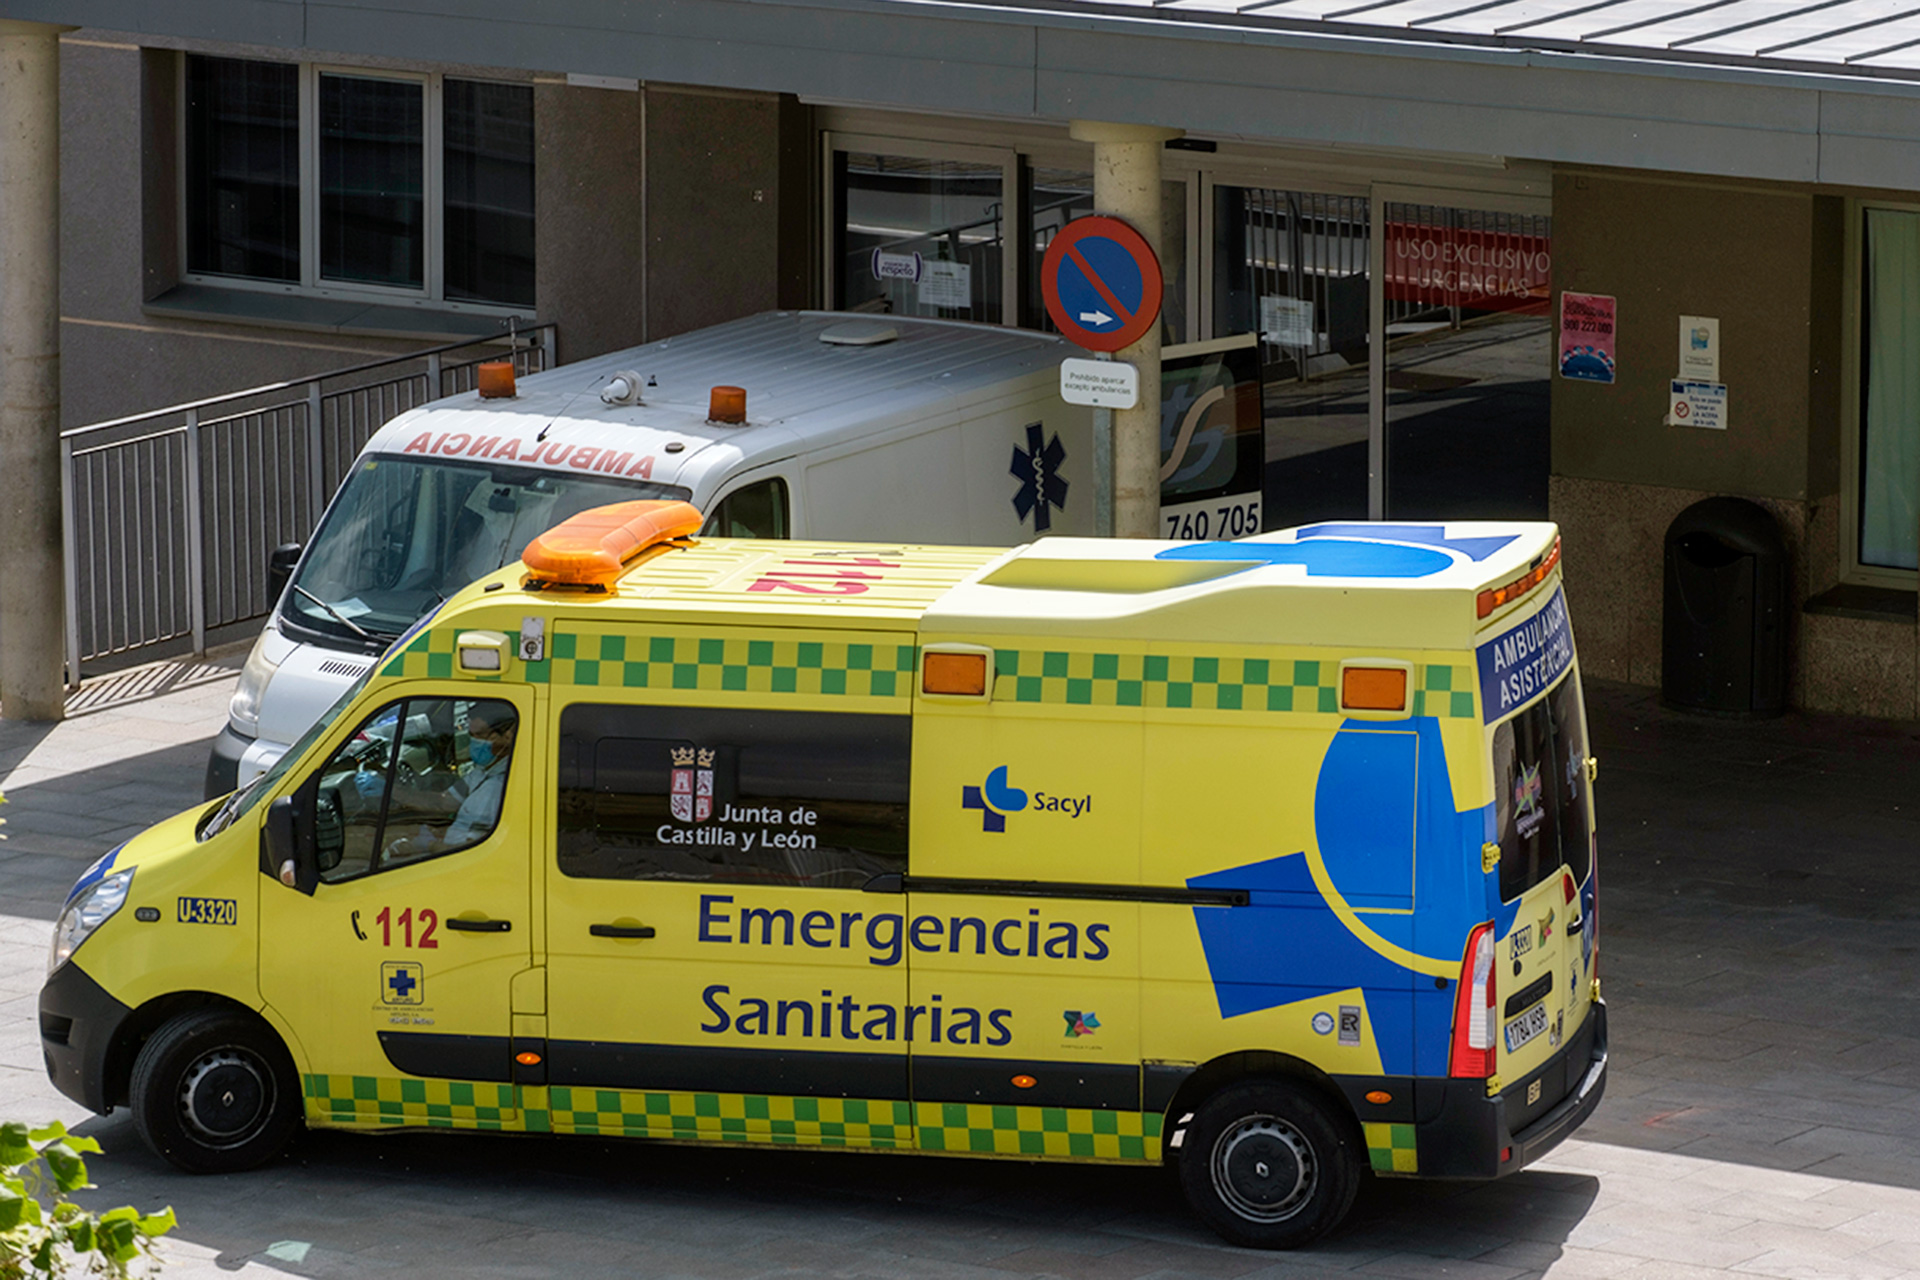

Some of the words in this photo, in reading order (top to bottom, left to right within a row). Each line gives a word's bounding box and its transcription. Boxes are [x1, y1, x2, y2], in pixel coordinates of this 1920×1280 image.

[1396, 237, 1437, 261] USO
[1442, 242, 1551, 273] EXCLUSIVO
[1417, 268, 1529, 299] URGENCIAS
[1581, 320, 1597, 333] 222
[1597, 321, 1613, 335] 000
[1064, 383, 1090, 391] excepto
[1091, 385, 1132, 395] ambulancias
[1069, 372, 1100, 383] Prohibido
[1101, 377, 1127, 385] aparcar
[1167, 510, 1209, 541] 760
[1217, 502, 1259, 538] 705
[718, 803, 783, 825] Junta
[788, 806, 818, 826] de
[1033, 791, 1091, 818] Sacyl
[656, 824, 736, 847] Castilla
[741, 831, 756, 852] y
[761, 829, 817, 849] León
[179, 899, 235, 924] U-3320
[375, 906, 439, 949] 112
[698, 894, 1110, 966] Emergencias
[700, 984, 1012, 1047] Sanitarias
